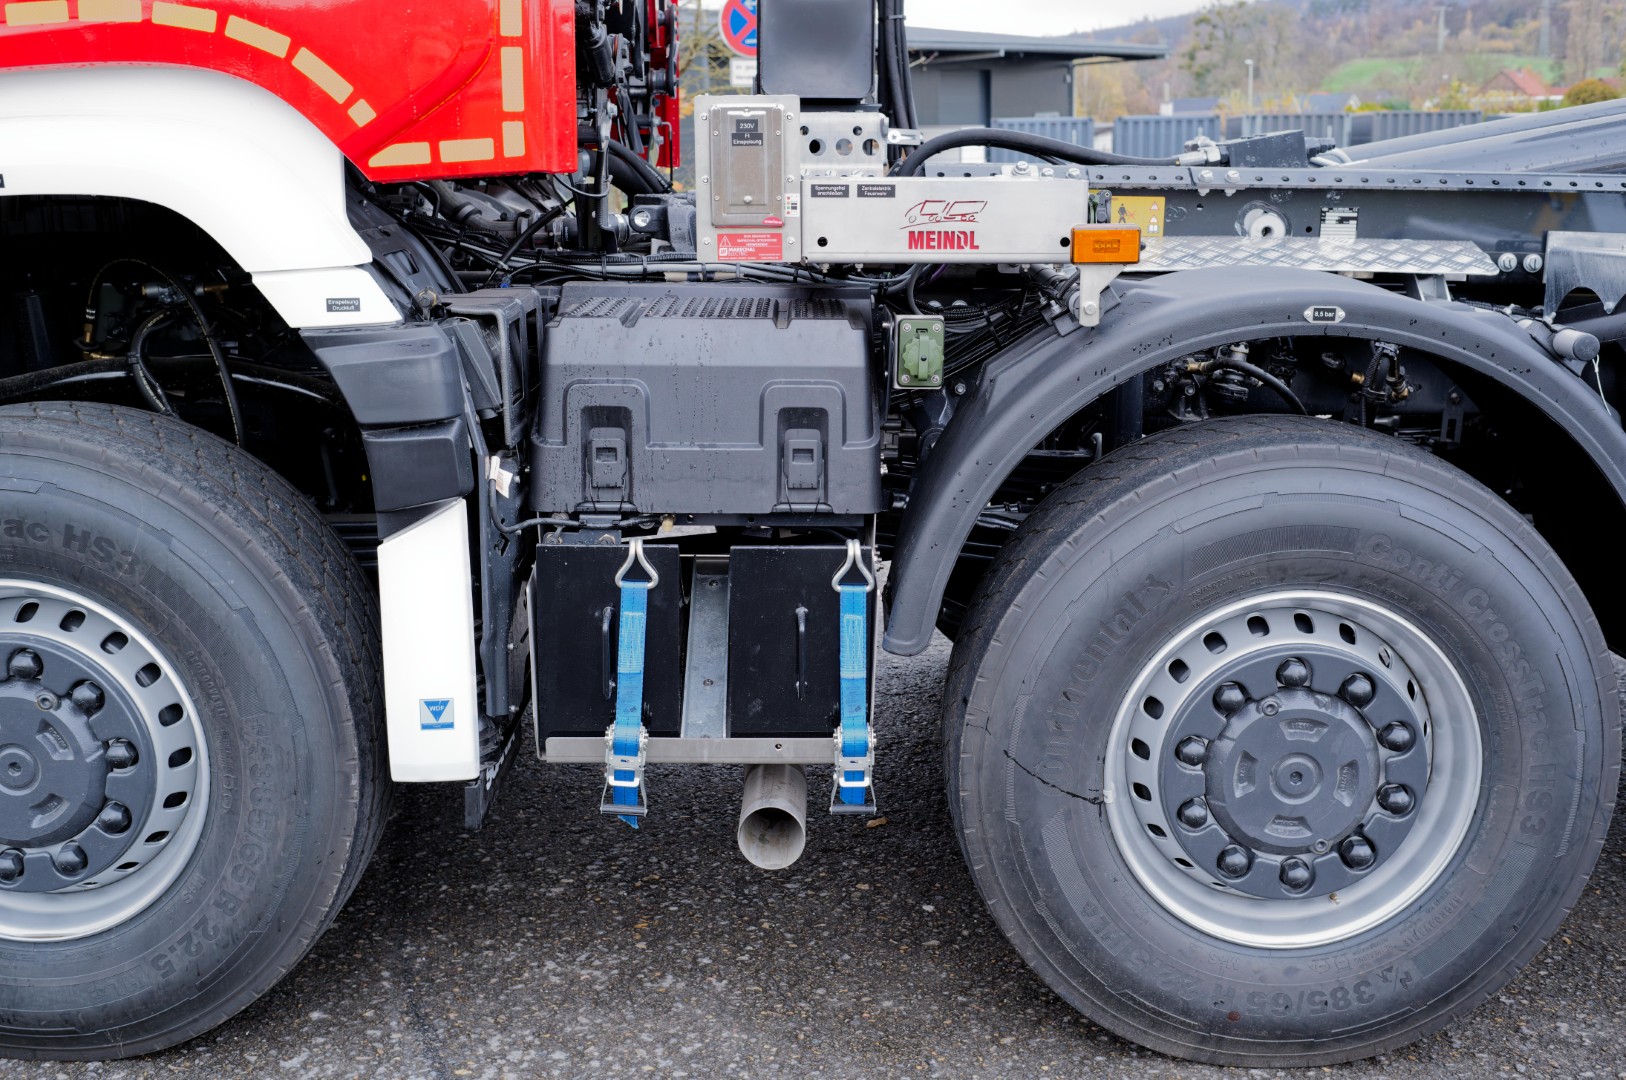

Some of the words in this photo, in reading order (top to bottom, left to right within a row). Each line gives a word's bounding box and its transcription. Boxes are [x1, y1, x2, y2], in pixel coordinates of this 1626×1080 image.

[908, 231, 980, 250] MEINDL
[62, 523, 140, 576] HS3
[212, 888, 241, 918] R
[150, 914, 220, 980] 22.5
[1246, 979, 1376, 1018] 385/65
